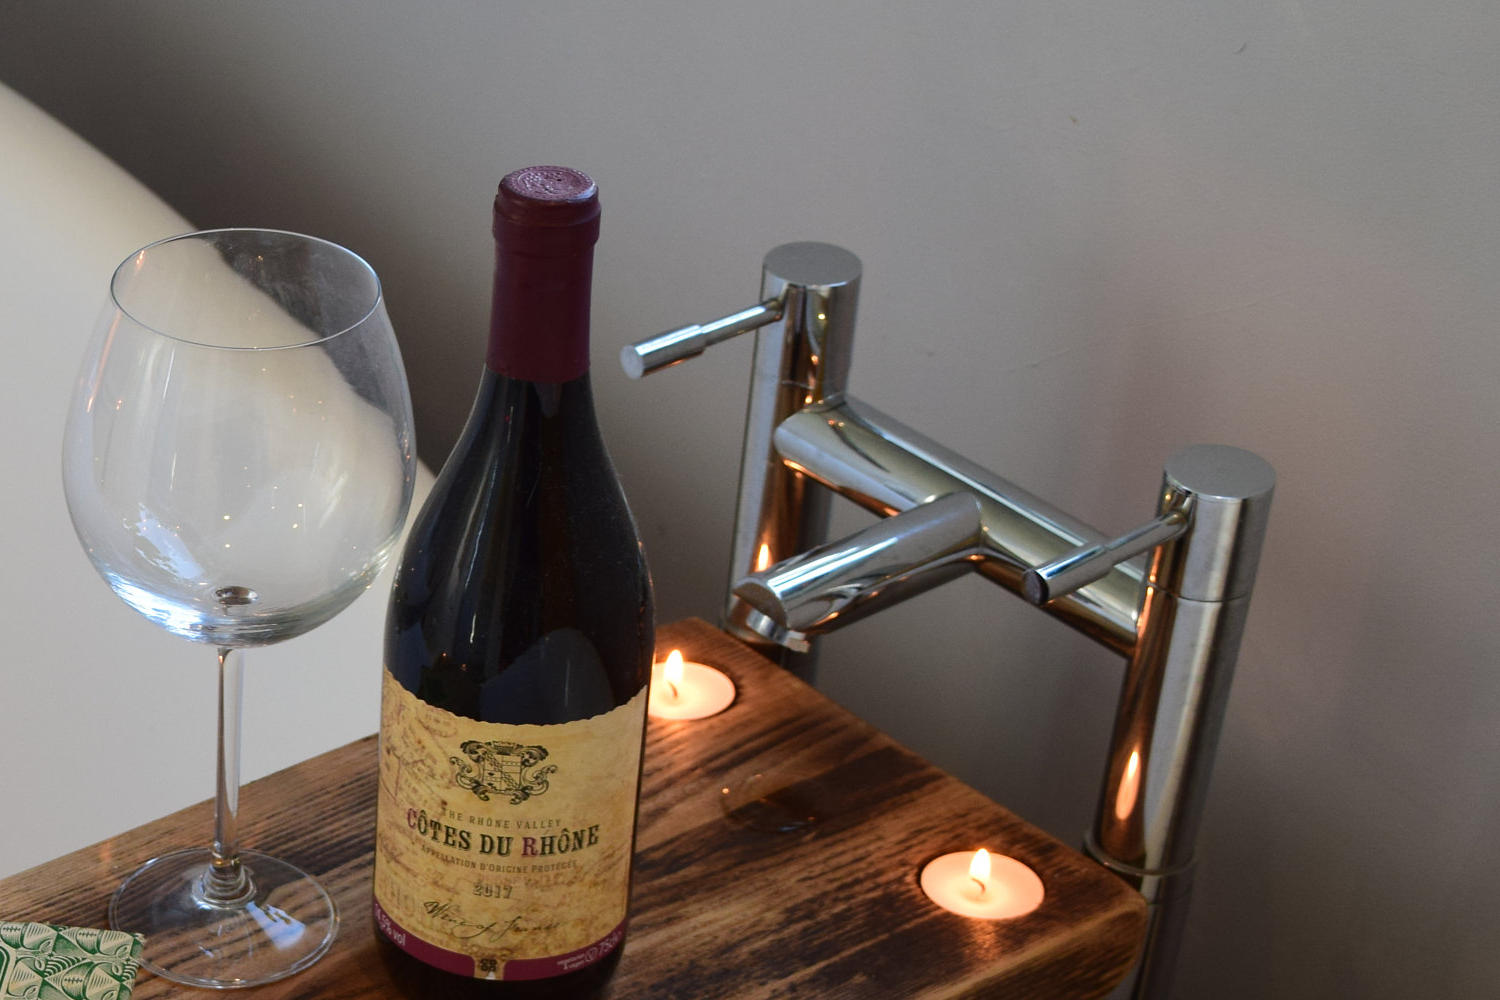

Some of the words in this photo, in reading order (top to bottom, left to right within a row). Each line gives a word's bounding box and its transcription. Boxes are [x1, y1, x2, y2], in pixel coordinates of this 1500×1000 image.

[441, 807, 463, 821] THE
[469, 813, 510, 829] RHÔNE
[516, 818, 563, 829] VALLEY
[407, 807, 472, 852] CÔTES
[479, 834, 514, 857] DU
[521, 823, 601, 857] RHÔNE
[421, 844, 477, 869] APPELLATION
[479, 862, 529, 874] D'ORIGINE
[473, 884, 513, 899] 2017
